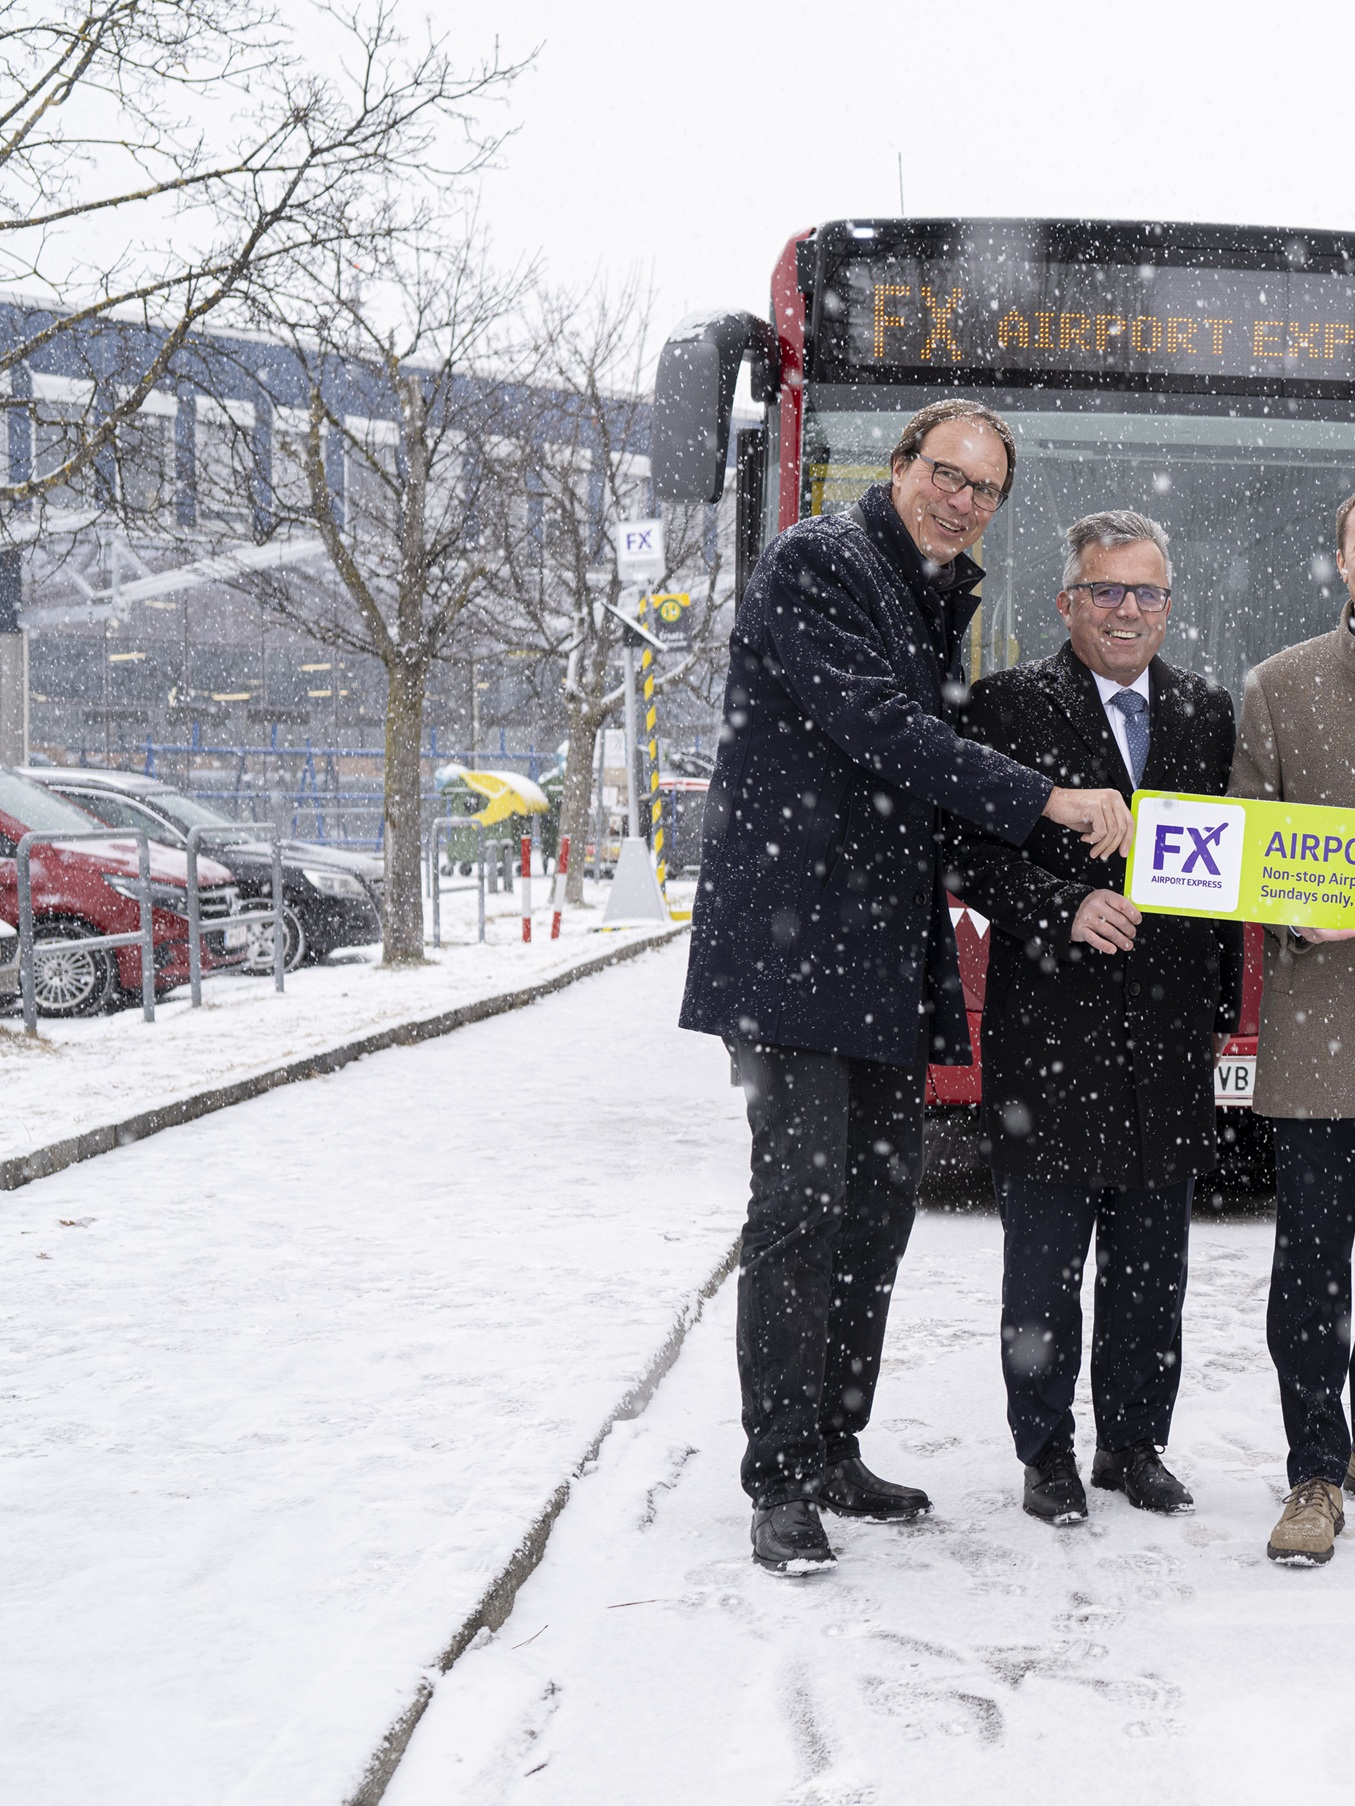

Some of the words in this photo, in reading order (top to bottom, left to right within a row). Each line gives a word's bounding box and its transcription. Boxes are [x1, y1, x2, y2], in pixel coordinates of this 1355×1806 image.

[873, 284, 962, 361] FX
[998, 311, 1233, 356] AIRPORT
[626, 528, 652, 550] FX
[1153, 822, 1229, 876] FX
[1151, 875, 1187, 886] AIRPORT
[1186, 878, 1222, 889] EXPRESS
[1262, 866, 1326, 886] Non-stop
[1260, 885, 1318, 904] Sundays
[1321, 892, 1354, 908] only,
